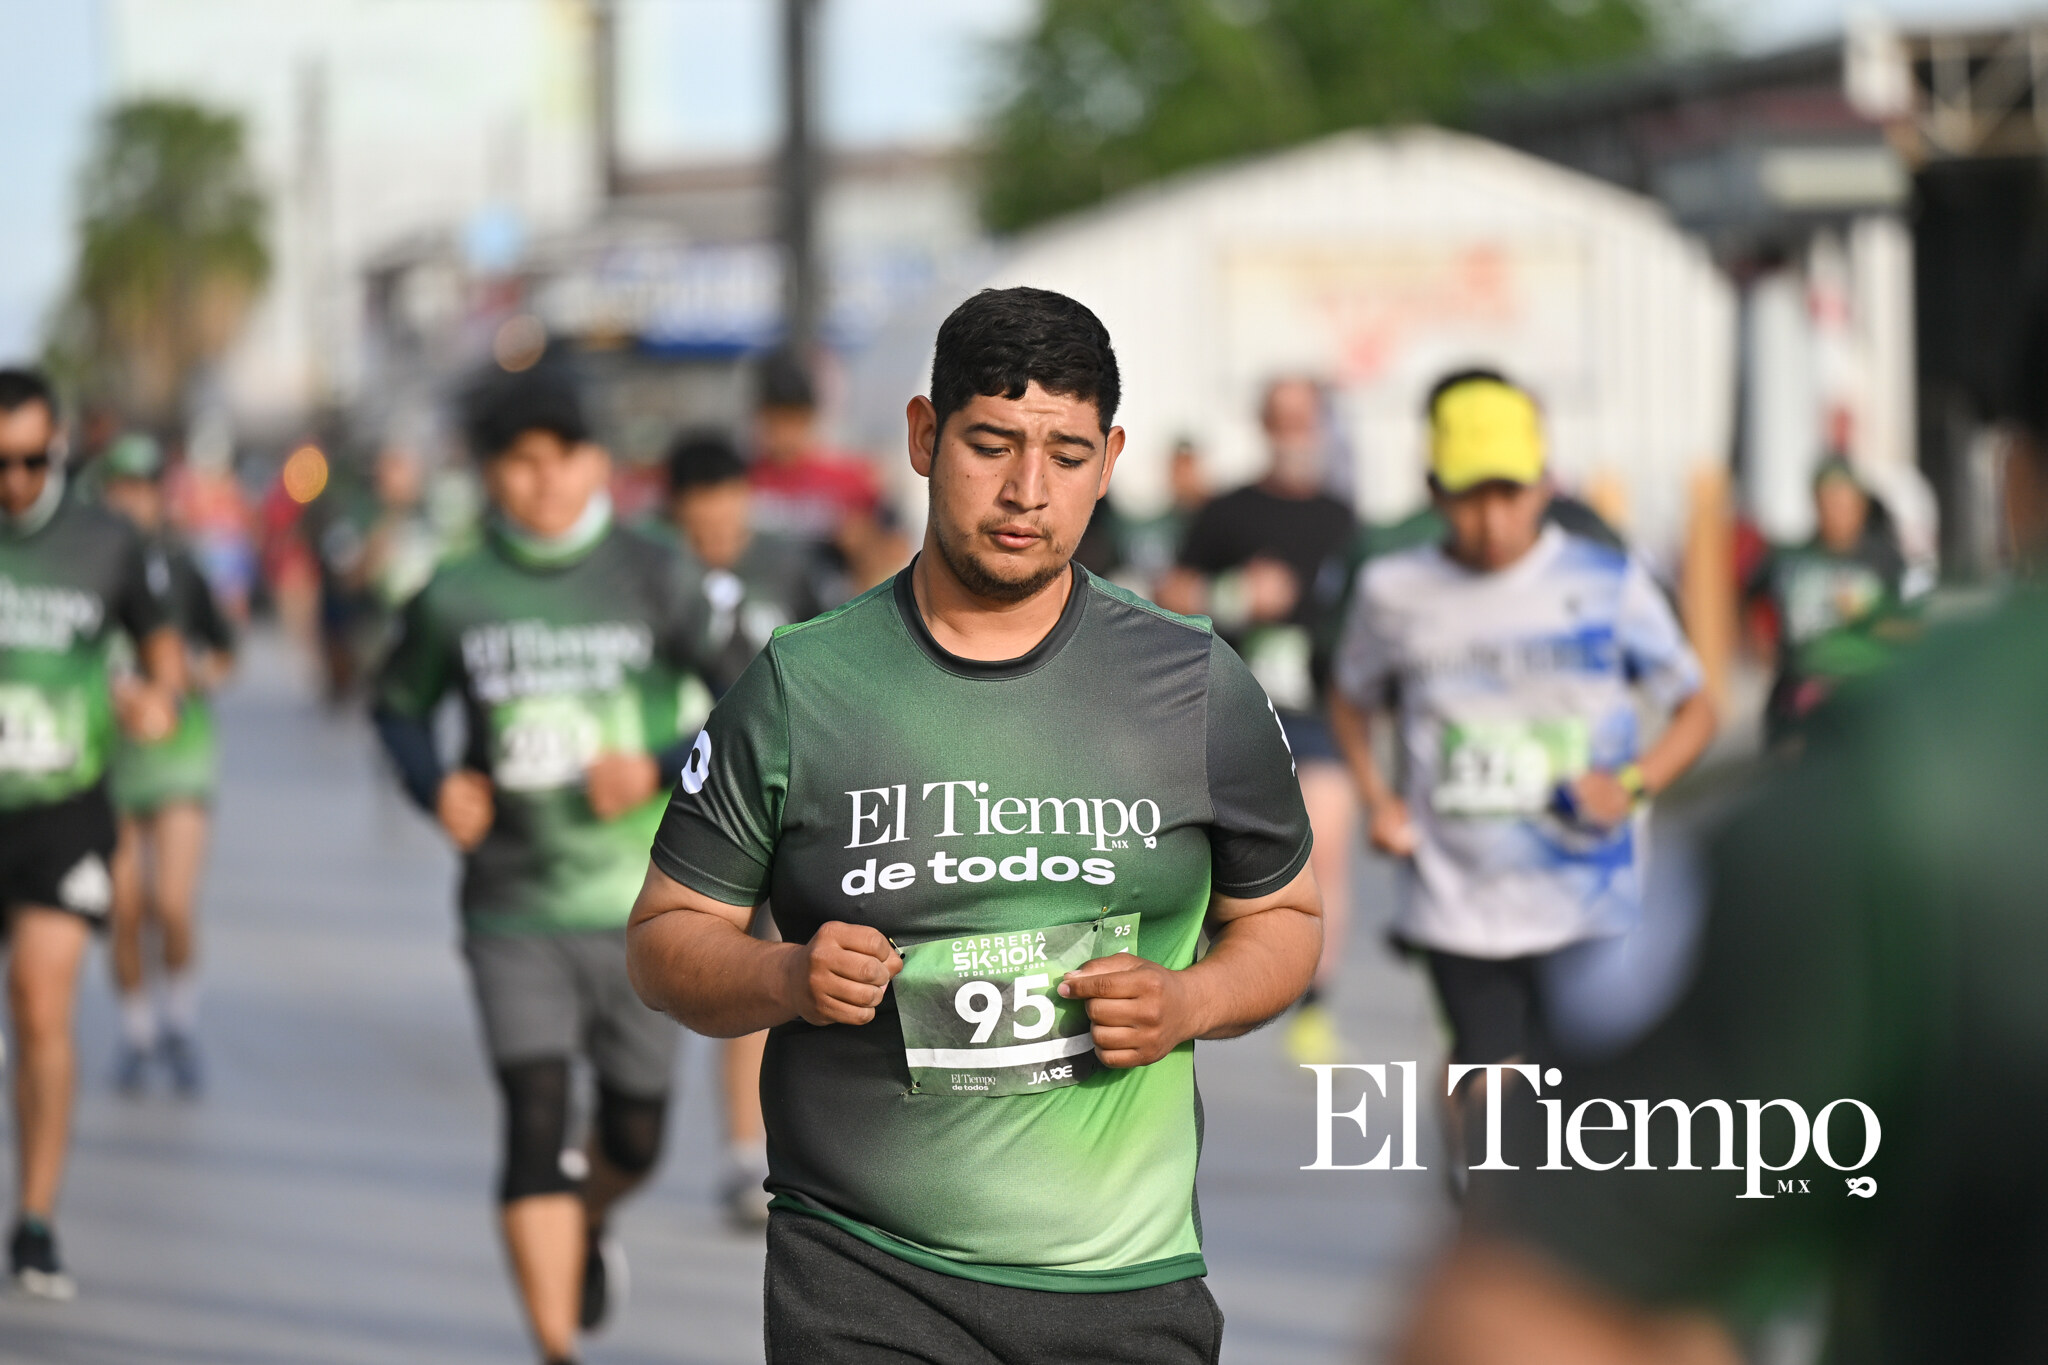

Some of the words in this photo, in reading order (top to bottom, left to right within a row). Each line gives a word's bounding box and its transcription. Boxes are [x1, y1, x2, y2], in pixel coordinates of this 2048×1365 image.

[844, 784, 910, 849] El
[922, 780, 1161, 852] Tiempo
[1111, 840, 1129, 849] MX
[841, 858, 916, 896] de
[927, 847, 1116, 885] todos
[1114, 924, 1131, 937] 95
[952, 931, 1046, 952] CARRERA
[988, 966, 1020, 975] MARZO
[954, 973, 1056, 1044] 95
[951, 1074, 960, 1084] El
[960, 1073, 996, 1086] Tiempo
